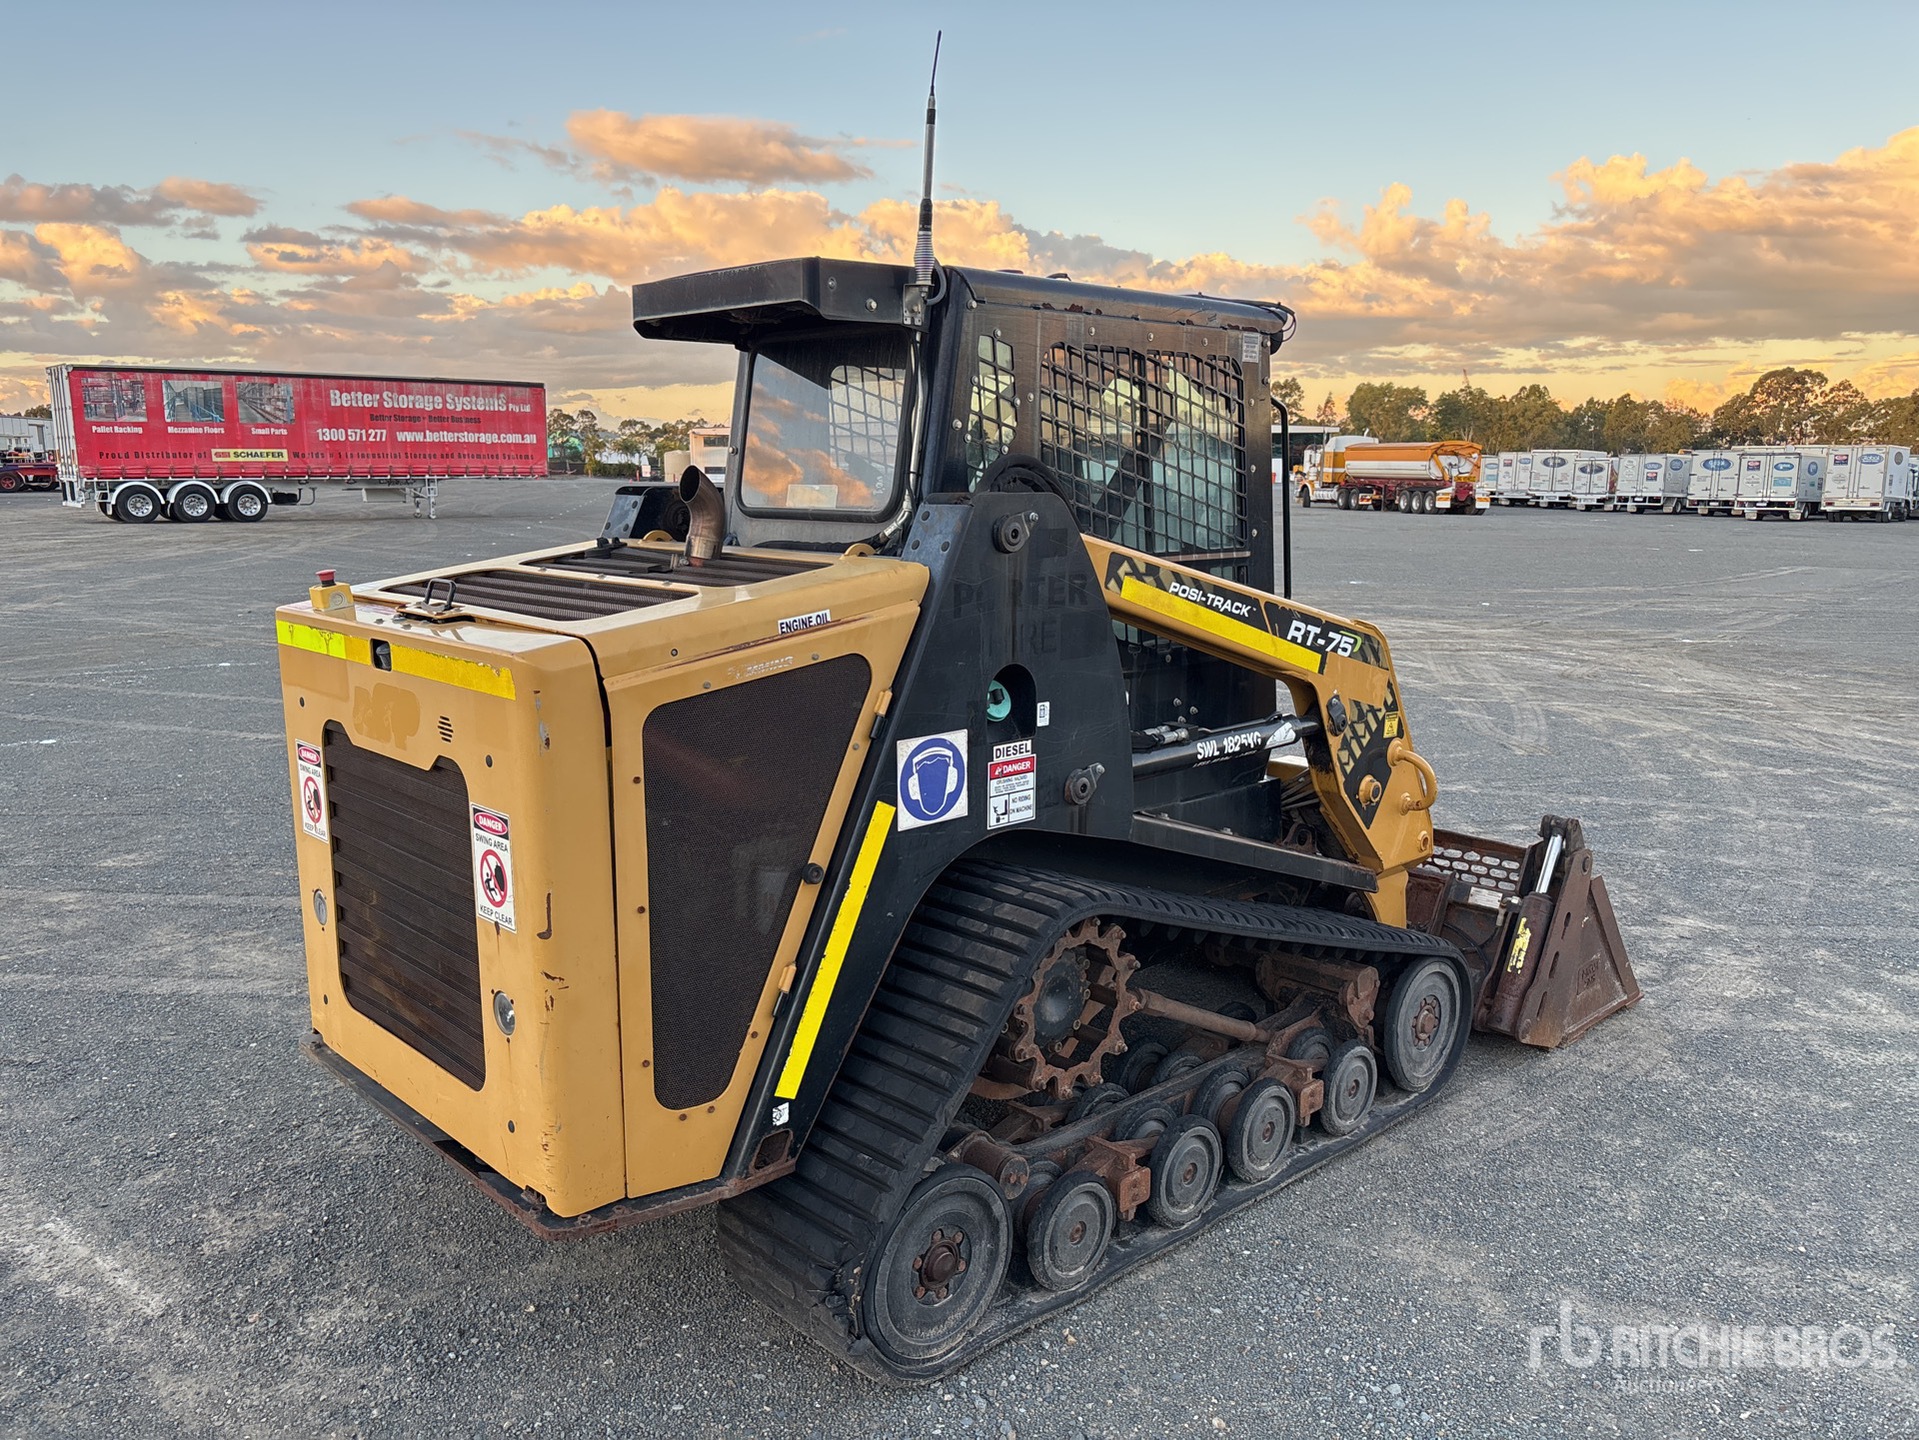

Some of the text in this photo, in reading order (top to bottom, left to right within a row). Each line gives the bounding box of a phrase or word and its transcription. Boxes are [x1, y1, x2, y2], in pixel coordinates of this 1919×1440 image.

[330, 390, 530, 412] Better Storage Systems Pty Ltd
[370, 414, 392, 422] Better
[394, 414, 422, 423] Storage
[428, 415, 449, 423] Better
[451, 416, 481, 424] Business
[92, 425, 143, 434] Pallet Racking
[167, 426, 225, 434] Mezzanine Floors
[251, 427, 288, 436] Small Parts
[316, 428, 387, 442] 1300 571 277
[396, 430, 536, 444] www.betterstorage.com.au
[99, 451, 130, 459] Proud
[134, 451, 193, 459] Distributor
[404, 452, 437, 460] Storage
[440, 452, 454, 460] and
[1168, 582, 1251, 618] POSI-TRACK
[780, 612, 830, 634] ENGINE OIL
[1286, 620, 1354, 658] RT-75
[301, 750, 317, 760] DANGER
[995, 742, 1030, 759] DIESEL
[1196, 740, 1220, 760] SWL
[300, 764, 321, 778] SWING AREA
[1003, 760, 1031, 774] DANGER
[1012, 794, 1031, 804] NO RIDING
[1016, 804, 1032, 814] MACHINE
[304, 822, 314, 832] KEEP
[478, 814, 503, 832] DANGER
[476, 833, 508, 852] SWING AREA
[480, 904, 513, 926] KEEP CLEAR
